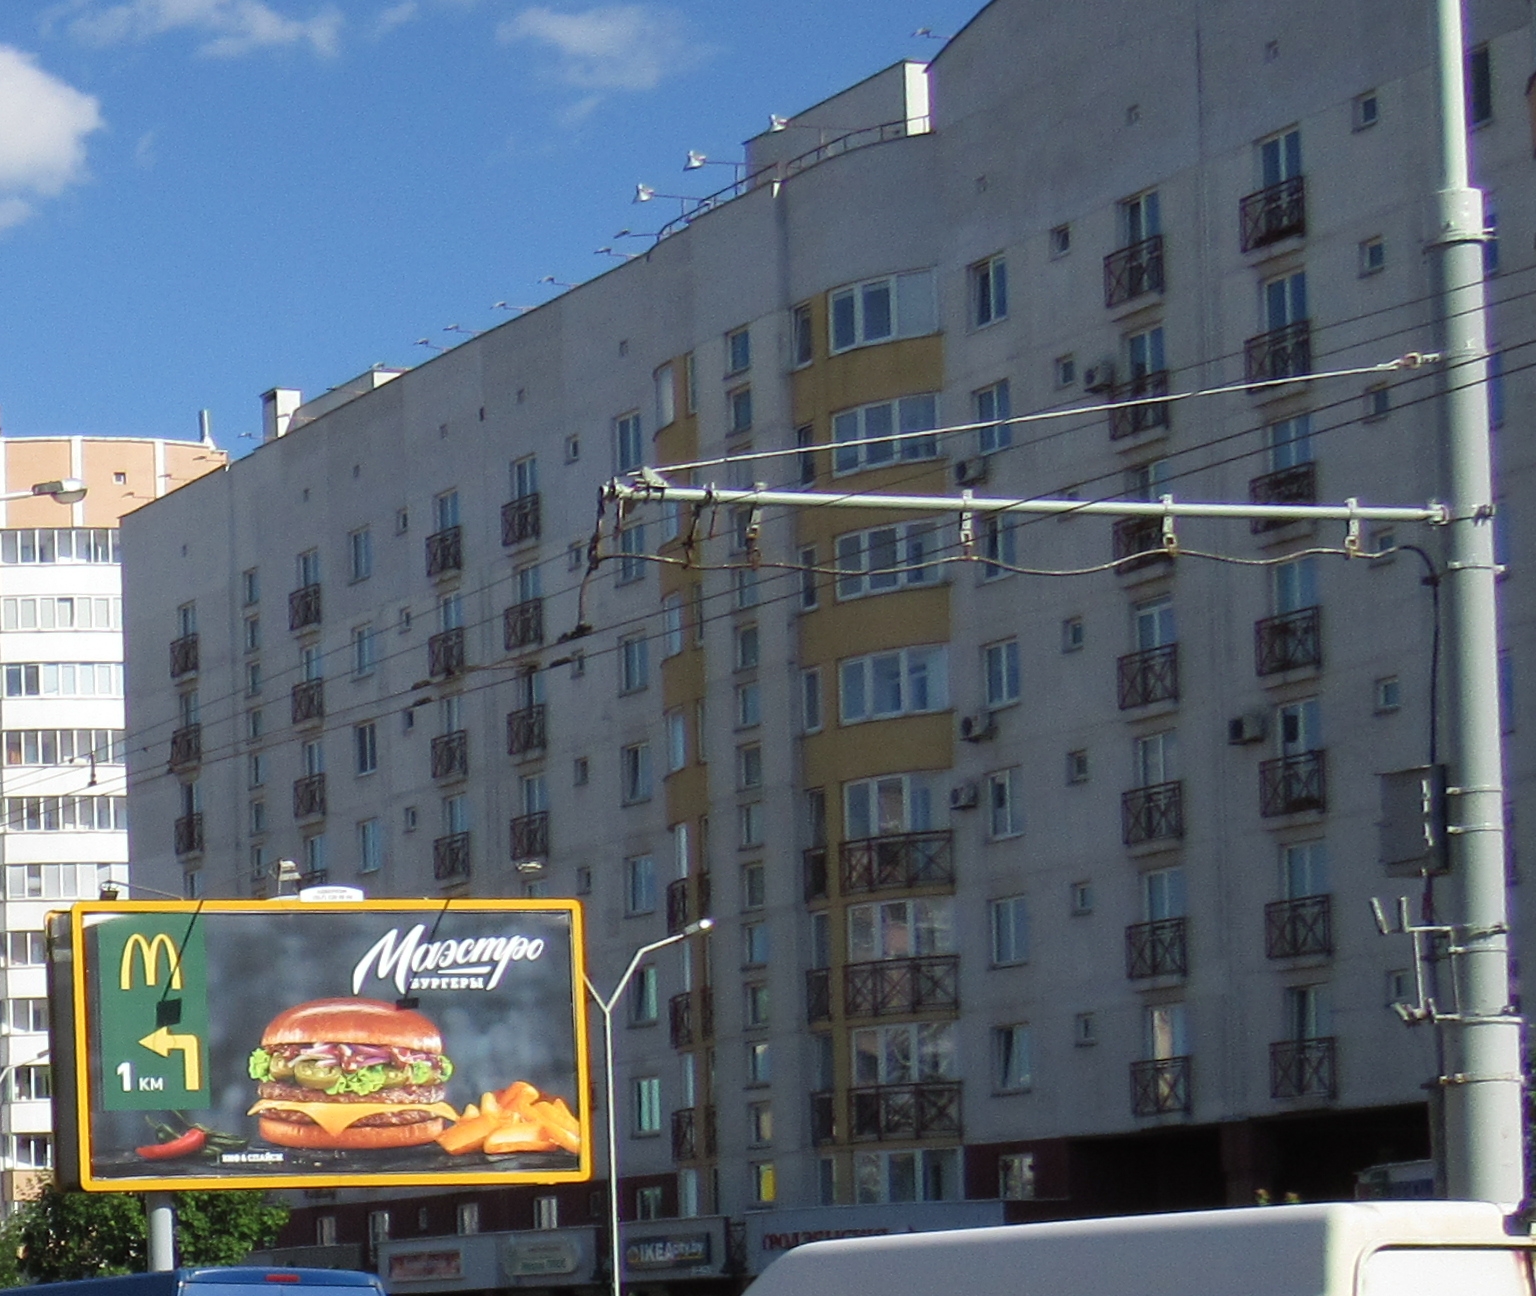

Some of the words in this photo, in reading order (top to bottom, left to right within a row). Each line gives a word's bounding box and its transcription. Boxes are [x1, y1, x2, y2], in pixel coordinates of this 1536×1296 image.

[352, 924, 545, 996] Маэстро
[410, 976, 485, 990] БУРГЕРЫ
[116, 1061, 132, 1092] 1
[138, 1076, 164, 1092] КМ
